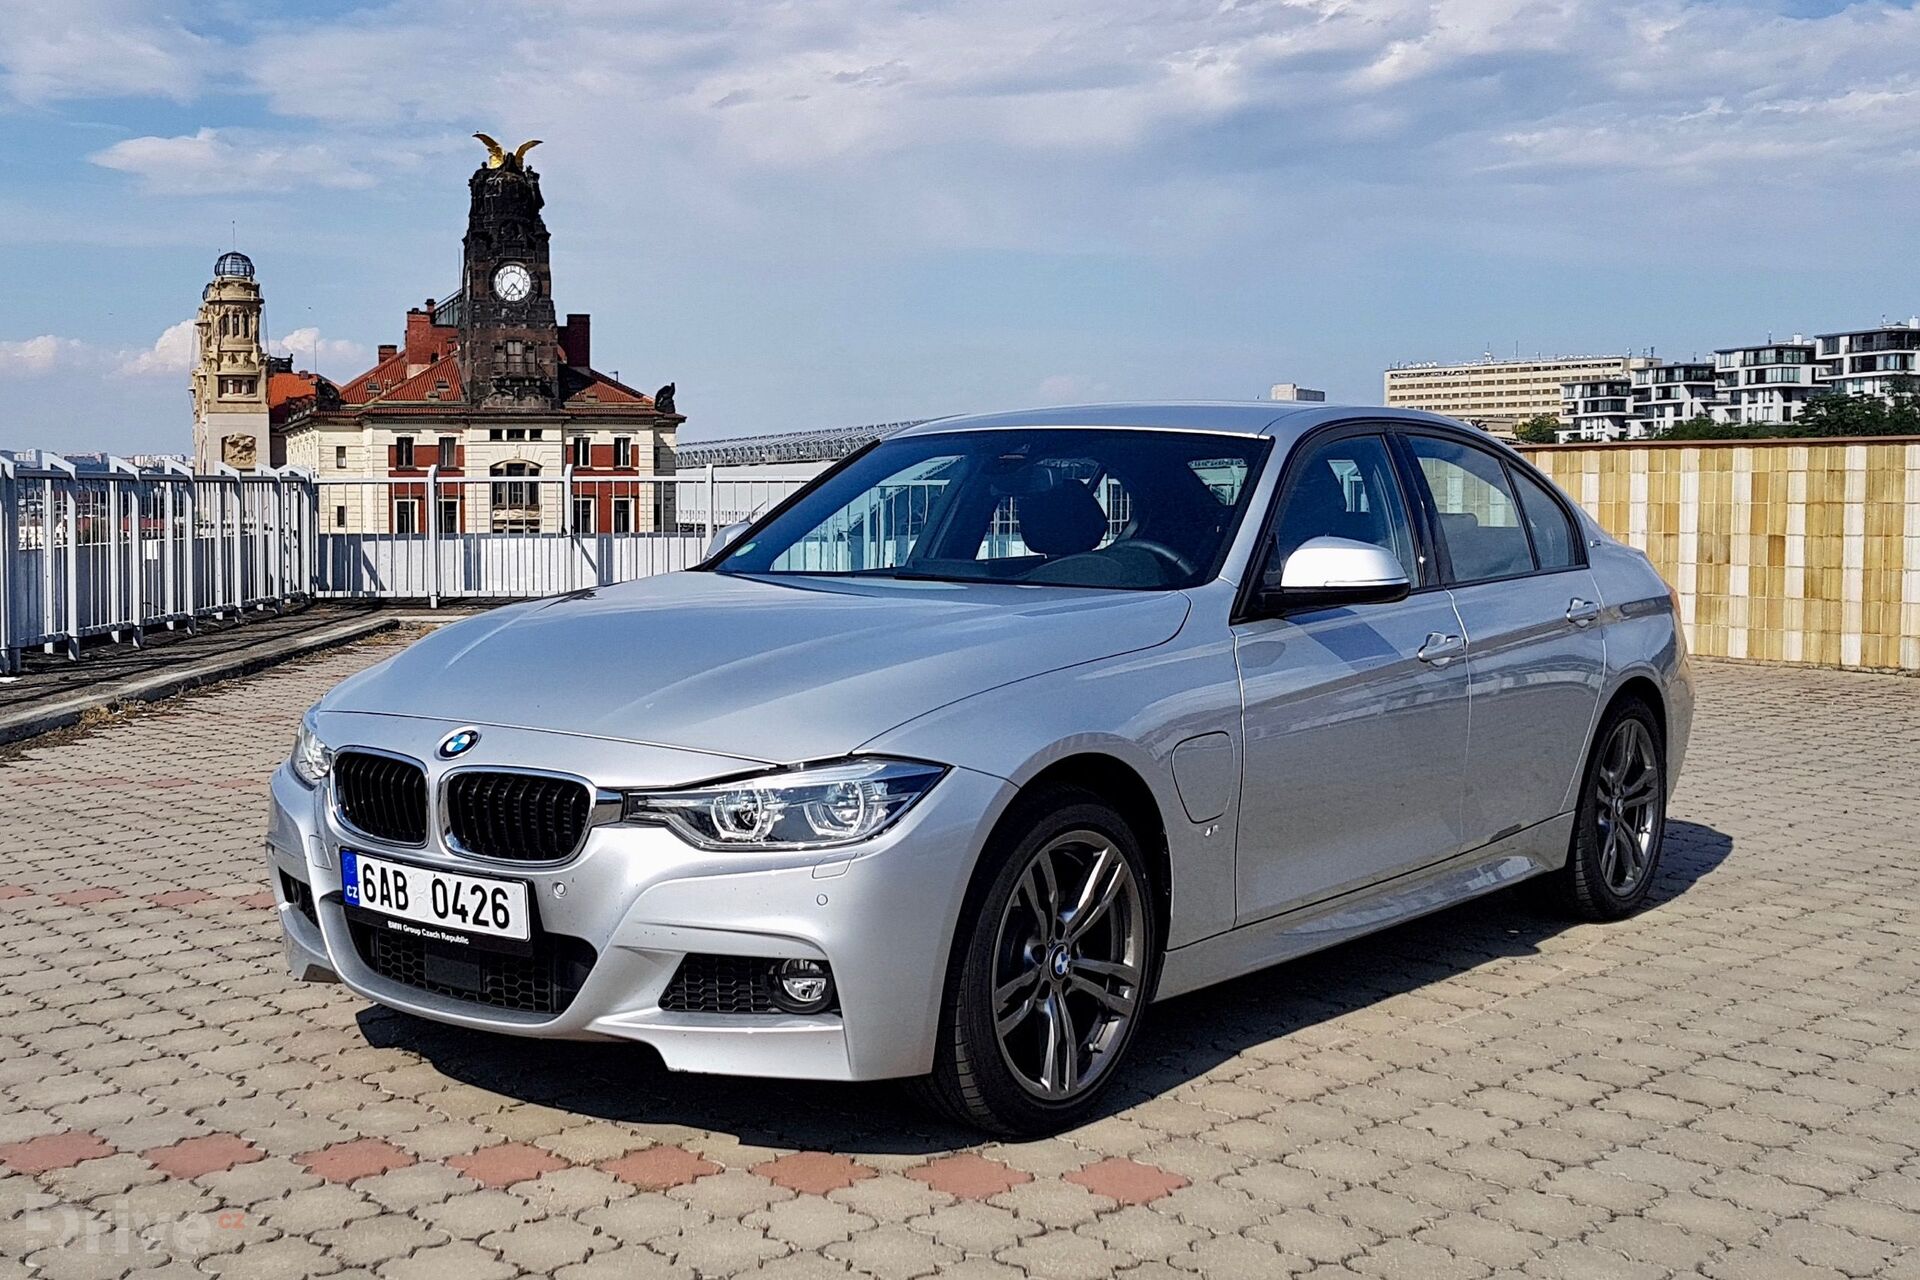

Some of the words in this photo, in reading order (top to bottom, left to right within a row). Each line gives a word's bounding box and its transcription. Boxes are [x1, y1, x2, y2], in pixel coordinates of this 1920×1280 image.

[346, 885, 358, 899] CZ
[363, 863, 409, 911] 6AB
[431, 878, 510, 930] 0426
[403, 924, 421, 936] Group
[421, 928, 441, 940] Czech
[441, 932, 470, 945] Republic
